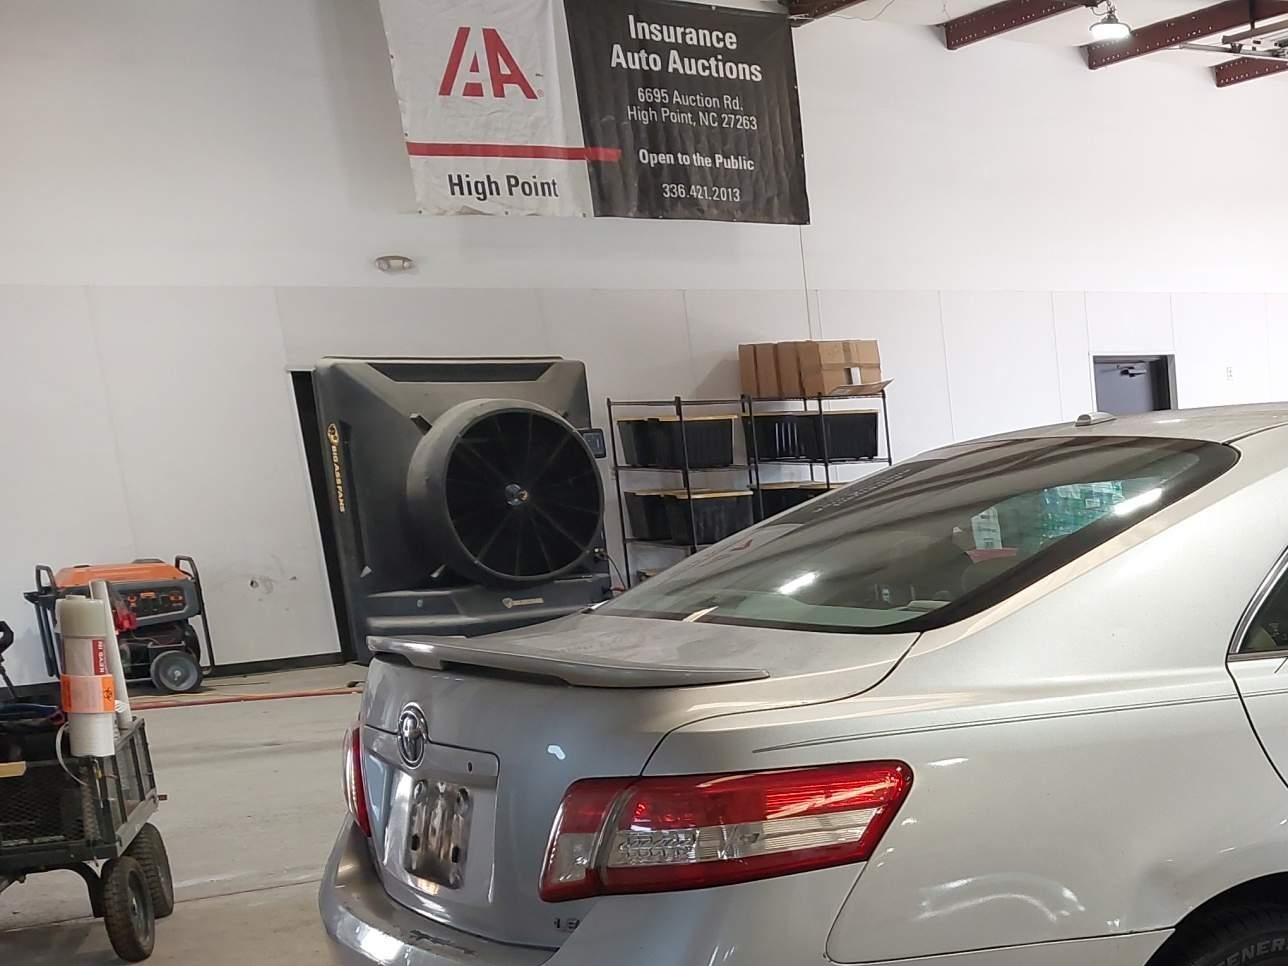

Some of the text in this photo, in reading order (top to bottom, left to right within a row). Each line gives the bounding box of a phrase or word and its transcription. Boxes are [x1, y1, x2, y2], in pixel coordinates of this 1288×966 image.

[627, 14, 738, 50] Insurance
[610, 43, 763, 82] Auto Auctions
[637, 87, 744, 111] 6695 Auction Rd.
[627, 105, 758, 130] High Point, NC 27263
[639, 149, 755, 171] Open to the Public
[447, 174, 559, 201] High Point
[662, 183, 741, 202] 336.421.2013
